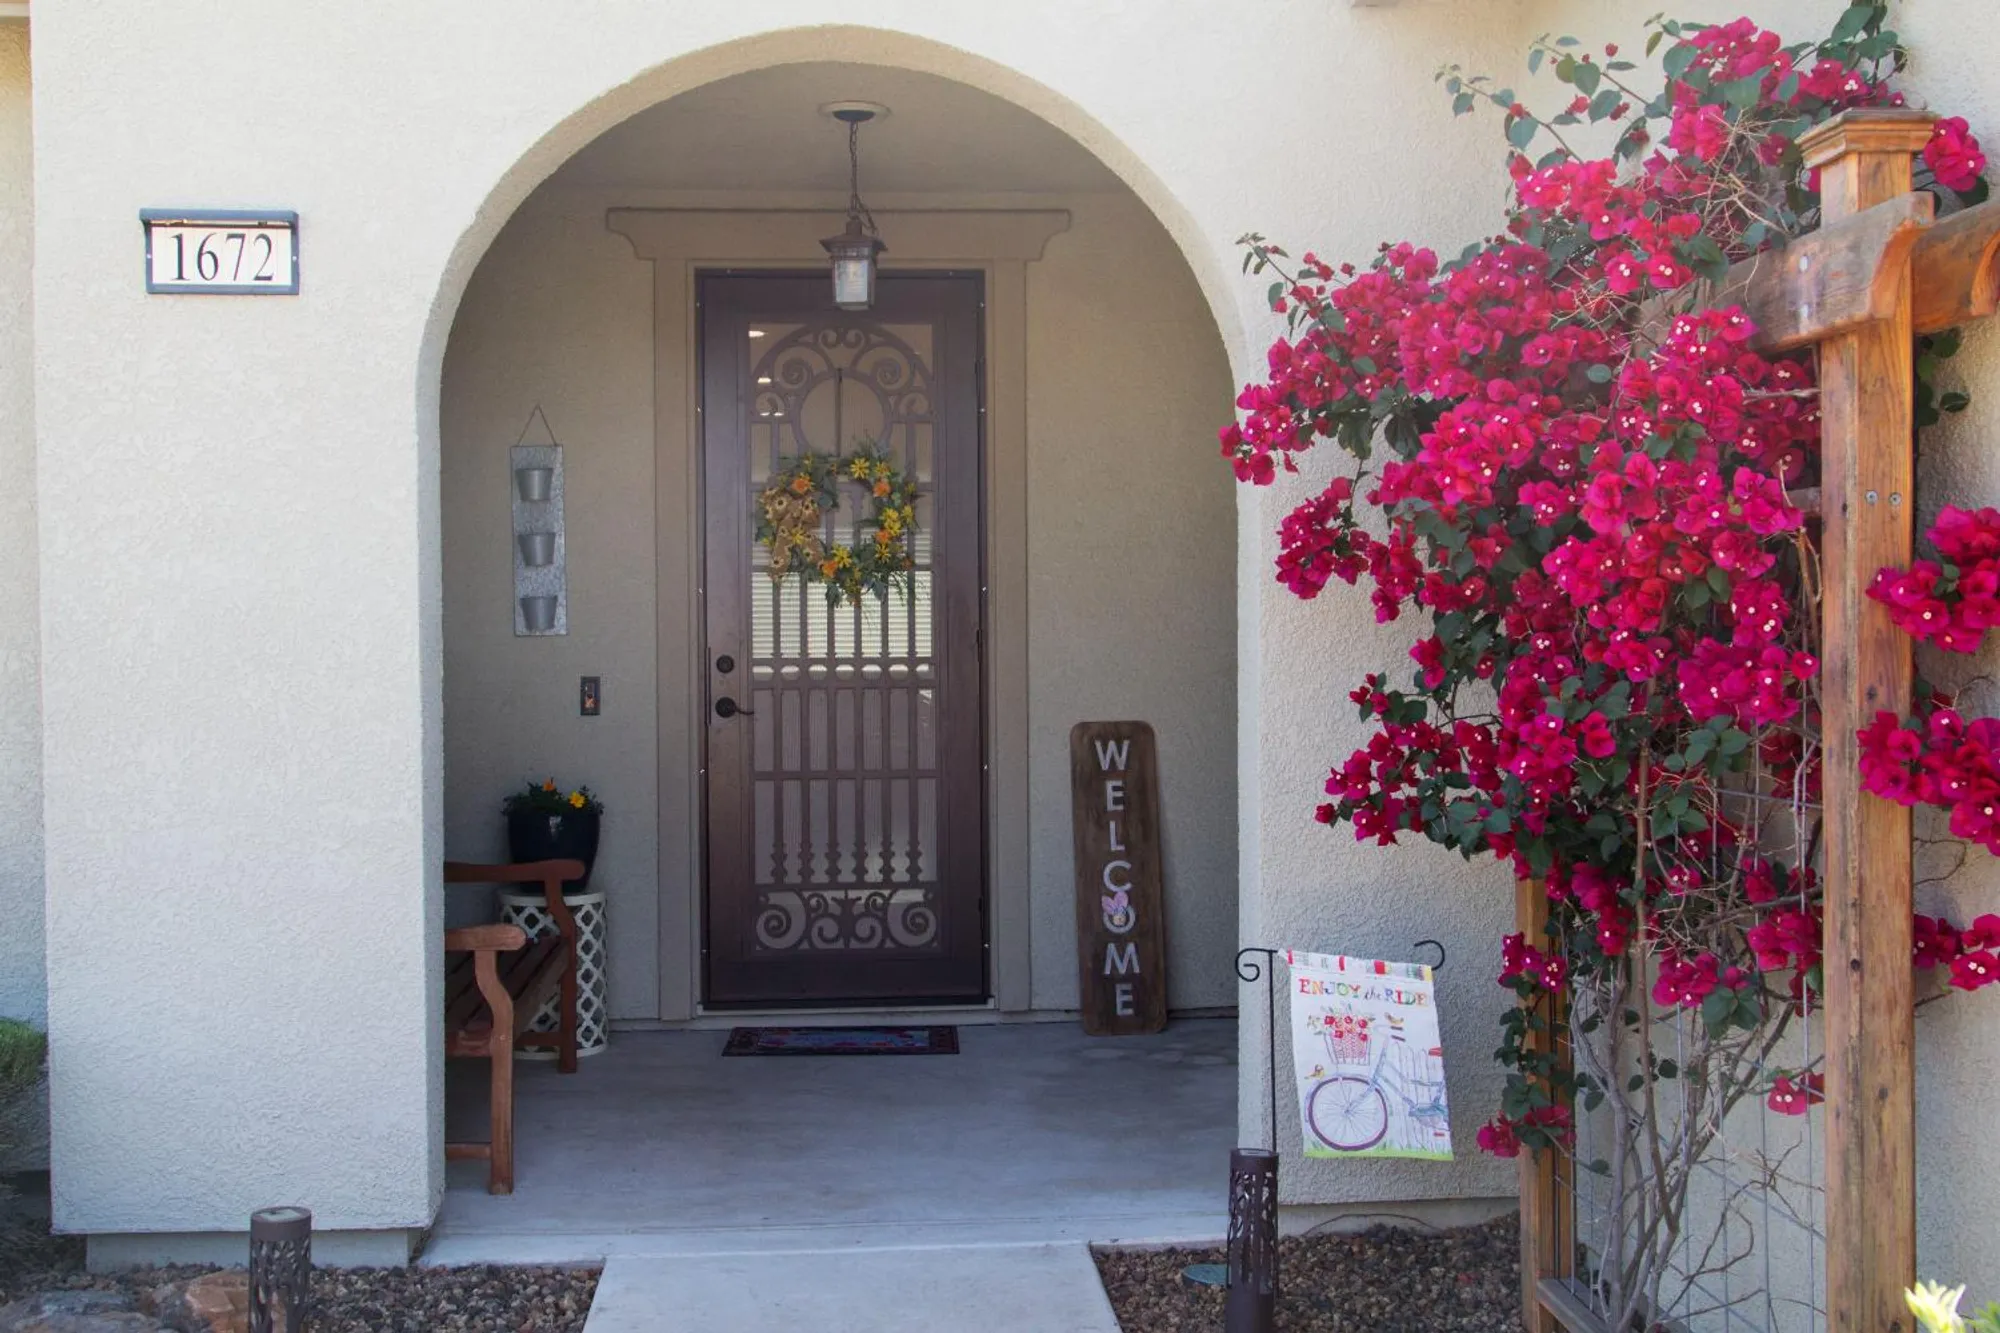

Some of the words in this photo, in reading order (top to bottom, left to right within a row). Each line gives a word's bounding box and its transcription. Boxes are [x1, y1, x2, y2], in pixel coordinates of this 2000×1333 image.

[170, 232, 274, 282] 1672
[1094, 739, 1141, 1017] WELCOME
[1298, 977, 1361, 998] ENJOY
[1364, 985, 1382, 1001] the
[1384, 986, 1428, 1006] RIDE
